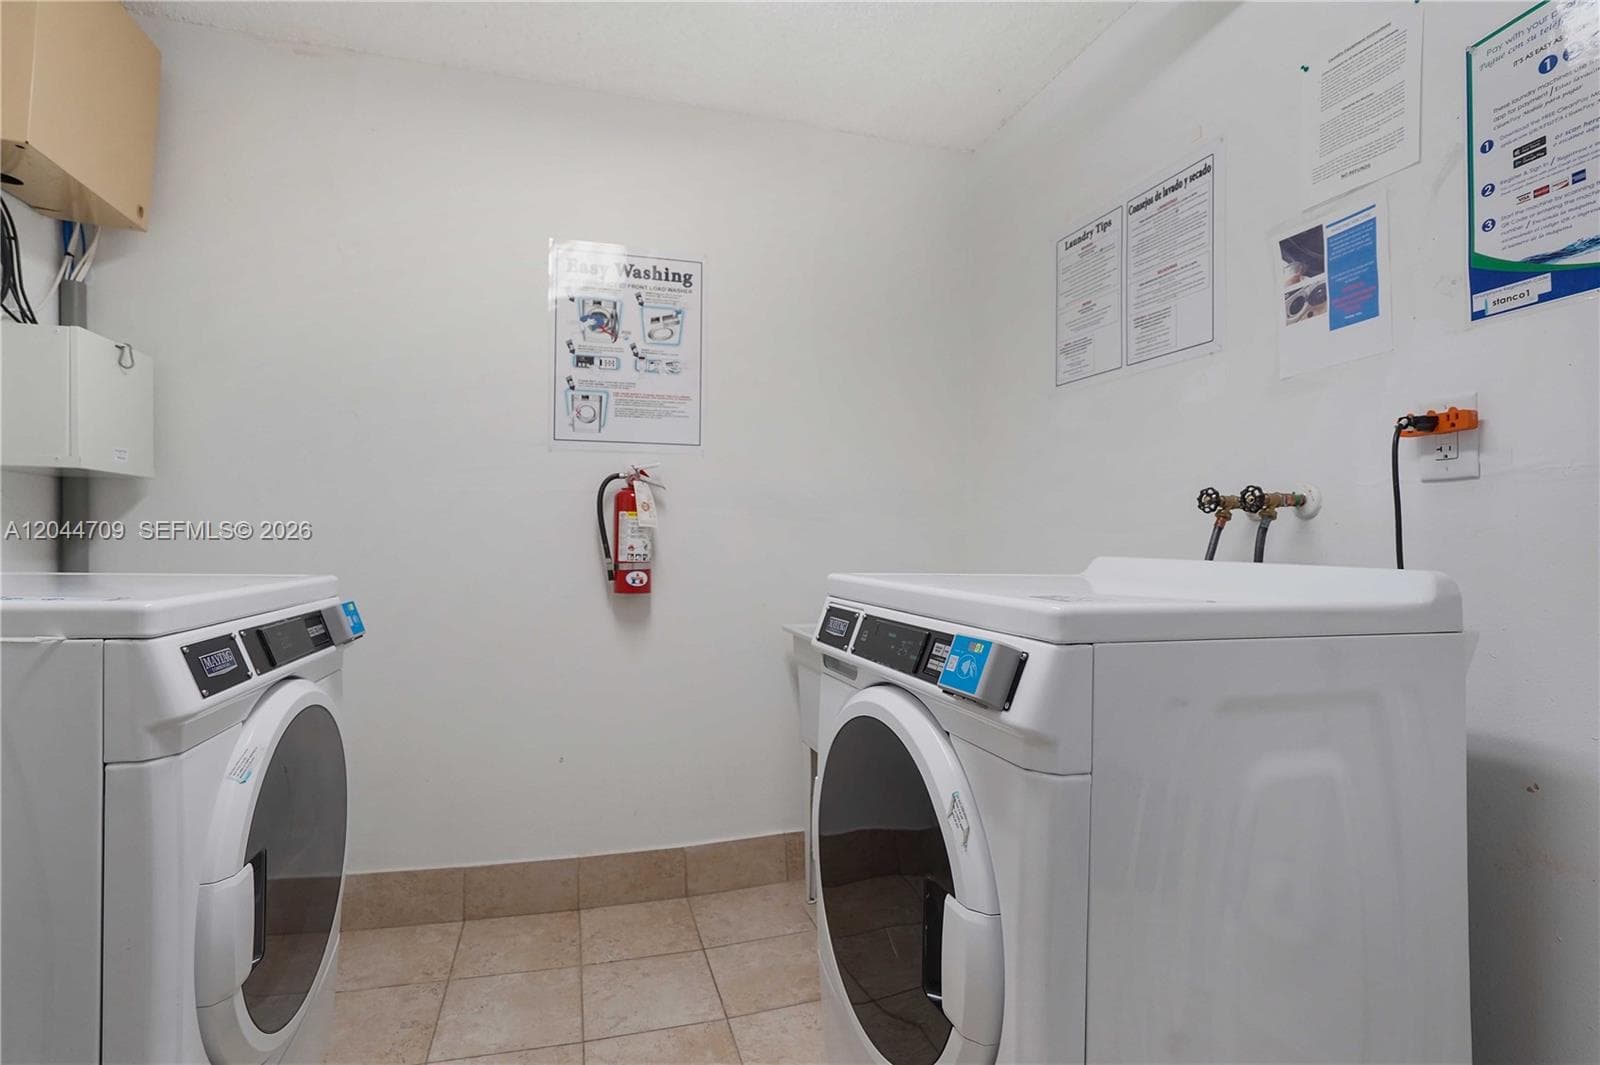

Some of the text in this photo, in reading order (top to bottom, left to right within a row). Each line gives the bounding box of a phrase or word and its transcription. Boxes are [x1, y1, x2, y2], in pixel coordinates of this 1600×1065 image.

[1486, 15, 1548, 56] Pay with your
[1526, 34, 1536, 44] su
[1525, 52, 1533, 60] AS
[1535, 42, 1551, 54] EASY
[1553, 35, 1562, 44] AS
[1537, 71, 1571, 91] machines
[1517, 91, 1547, 110] payment
[1565, 125, 1581, 135] scan
[1128, 197, 1154, 216] Consejos
[1155, 191, 1162, 202] de
[1162, 180, 1183, 198] lavado
[1189, 164, 1211, 183] secado
[1484, 185, 1491, 196] 2
[1526, 199, 1553, 210] machine
[1564, 184, 1592, 197] scanning
[1536, 203, 1562, 215] entering
[1065, 218, 1112, 251] Laundry Tips
[1485, 220, 1492, 231] 3
[566, 257, 693, 288] Easy Washing
[1492, 290, 1529, 306] stanco1
[203, 650, 233, 670] MAYTAG
